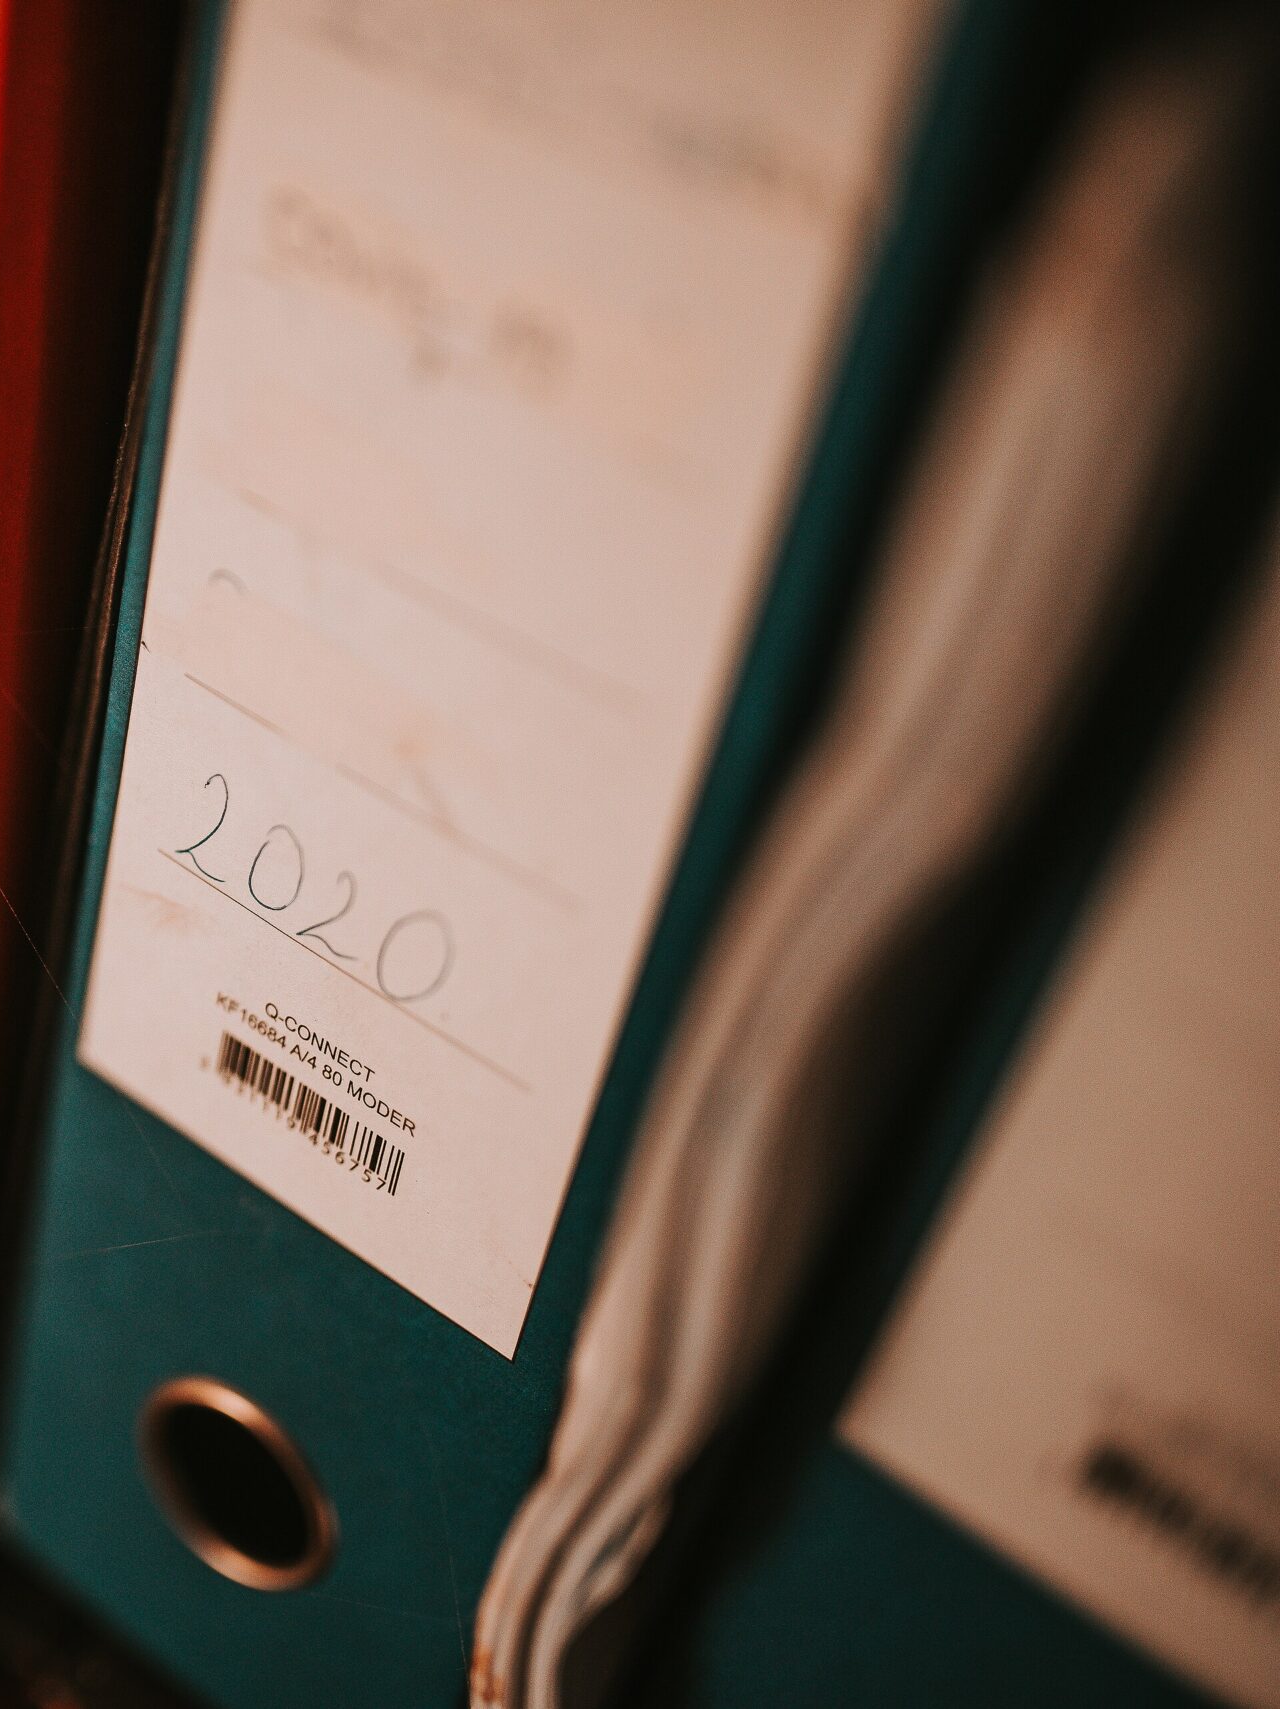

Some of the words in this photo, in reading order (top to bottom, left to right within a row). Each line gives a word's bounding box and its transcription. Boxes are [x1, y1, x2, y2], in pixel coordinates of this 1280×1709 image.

[175, 773, 456, 1002] 2020
[265, 1002, 376, 1082] Q-CONNECT
[322, 1065, 343, 1087] 80
[346, 1080, 417, 1138] MODER
